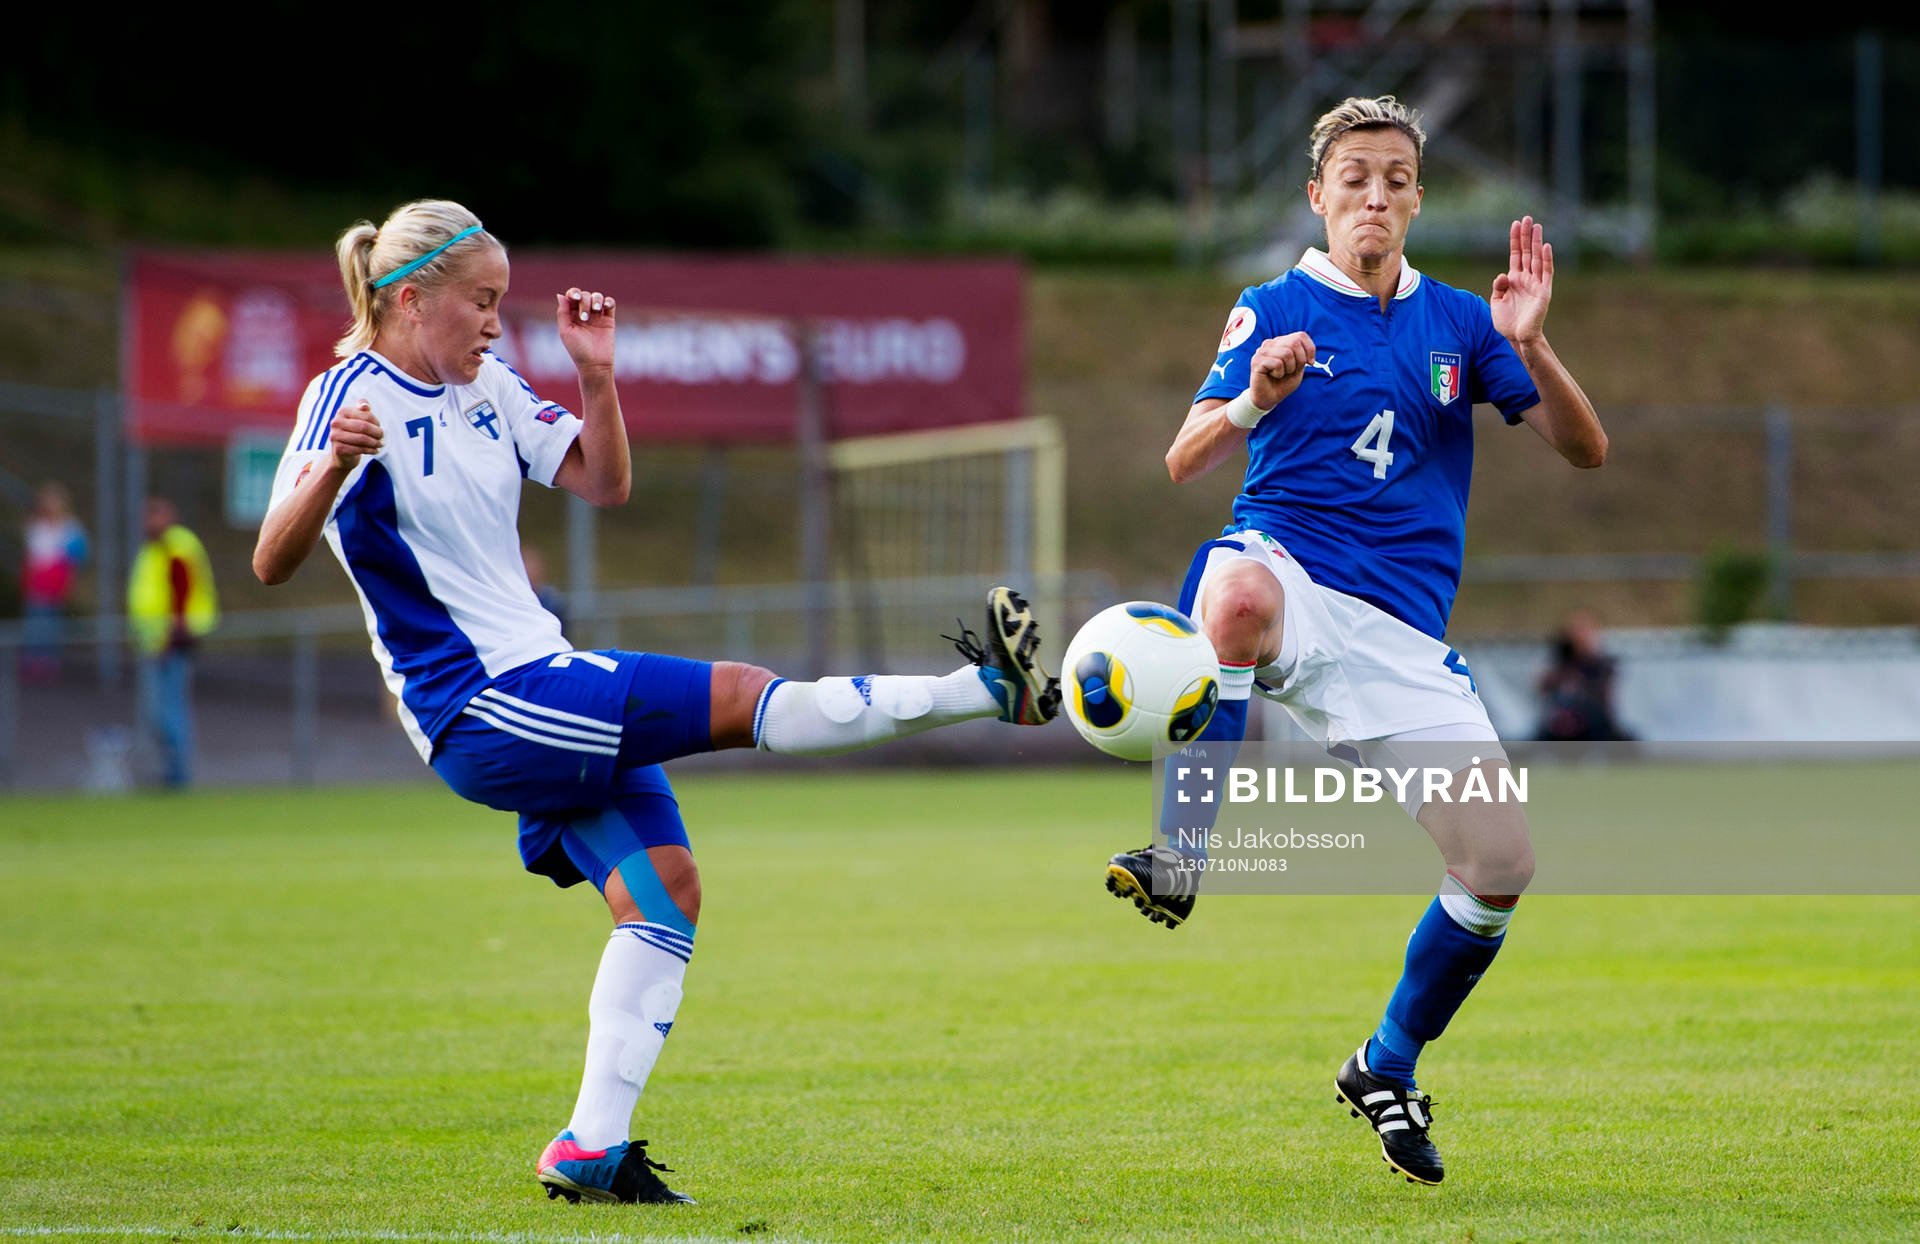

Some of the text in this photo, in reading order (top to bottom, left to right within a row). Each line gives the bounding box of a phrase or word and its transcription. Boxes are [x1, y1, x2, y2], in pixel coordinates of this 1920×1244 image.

[523, 318, 800, 384] WMEN'S
[1434, 356, 1456, 364] ITALIA
[405, 415, 434, 477] 7
[1351, 409, 1395, 480] 4
[1180, 747, 1207, 758] ALIA
